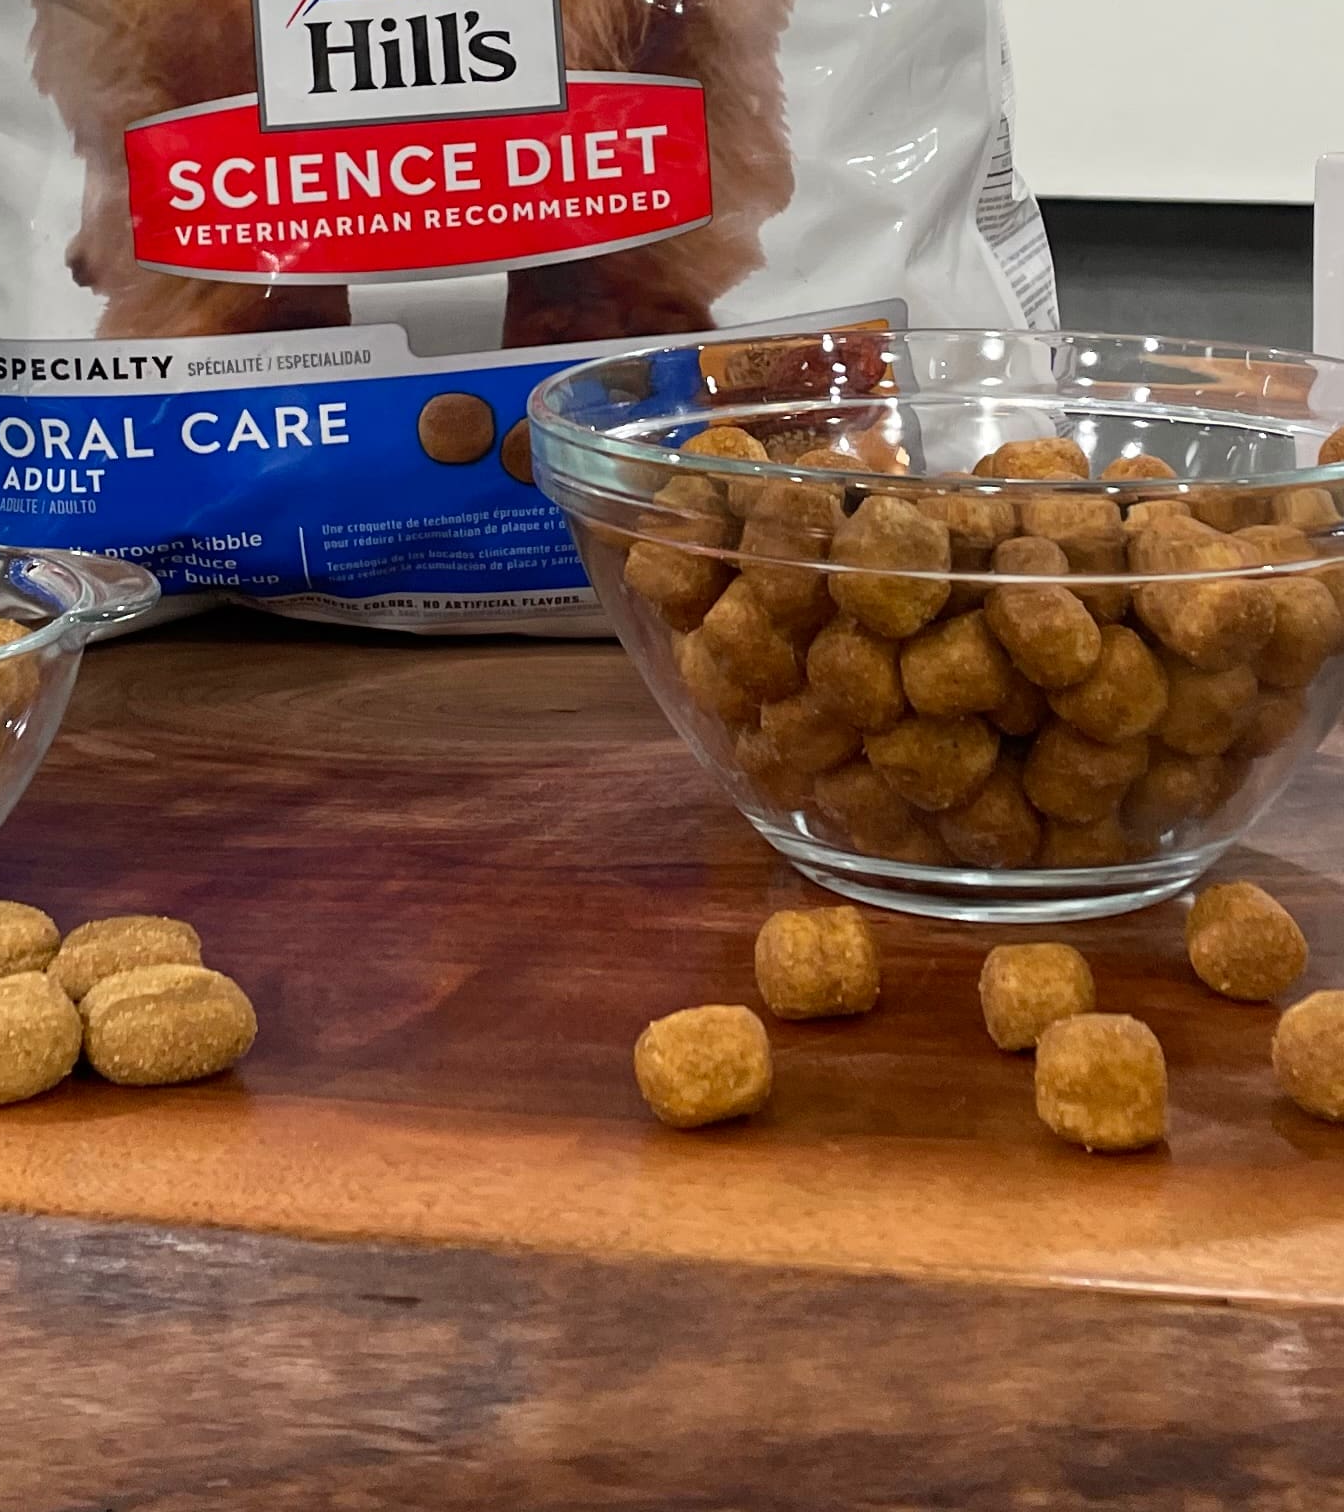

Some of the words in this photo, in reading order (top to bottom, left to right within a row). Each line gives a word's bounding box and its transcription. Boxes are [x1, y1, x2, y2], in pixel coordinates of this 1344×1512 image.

[304, 9, 517, 96] Hill's
[168, 141, 482, 212] SCIENCE
[505, 125, 669, 189] DIET
[174, 210, 413, 247] VETERINARIAN
[424, 189, 672, 230] RECOMMENDED
[187, 356, 264, 377] SPÉCIALITÉ
[277, 349, 371, 371] ESPECIALIDAD
[181, 402, 350, 454] CARE
[2, 466, 105, 493] ADULT
[0, 497, 38, 514] ADULTE
[49, 499, 96, 515] ADULTO
[406, 518, 420, 529] de
[484, 523, 498, 535] de
[104, 540, 185, 558] proven
[192, 532, 262, 552] kibble
[160, 554, 237, 570] reduce
[185, 569, 280, 586] build-up
[423, 600, 440, 609] NO
[445, 598, 517, 609] ARTIFICIAL
